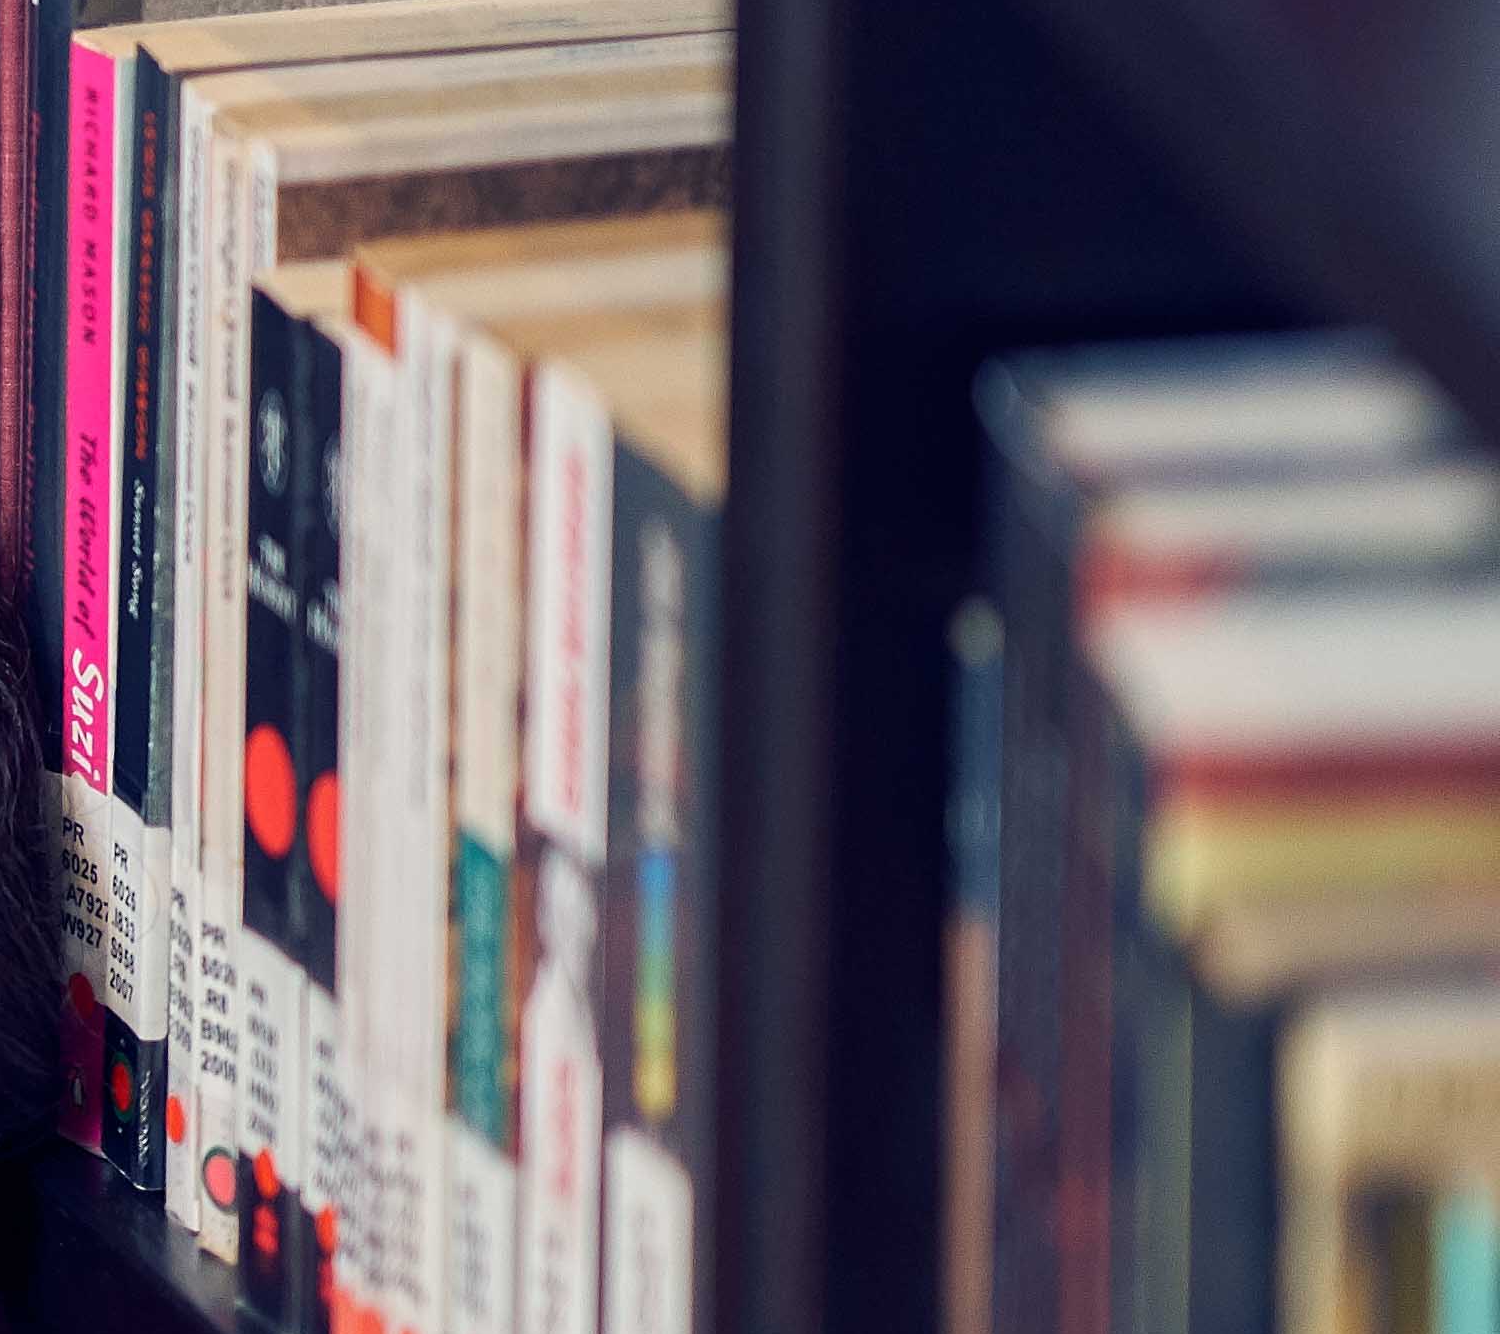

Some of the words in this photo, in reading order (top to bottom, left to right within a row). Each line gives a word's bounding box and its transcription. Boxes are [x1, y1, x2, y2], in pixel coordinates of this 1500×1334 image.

[83, 87, 98, 222] RICHARD
[82, 239, 97, 345] MASON
[79, 432, 98, 486] The
[78, 496, 97, 599] World
[73, 599, 96, 640] of
[62, 817, 85, 847] PR
[61, 848, 98, 885] 6025
[113, 842, 128, 873] PR
[112, 874, 136, 913] 6025
[109, 968, 134, 1004] 2007
